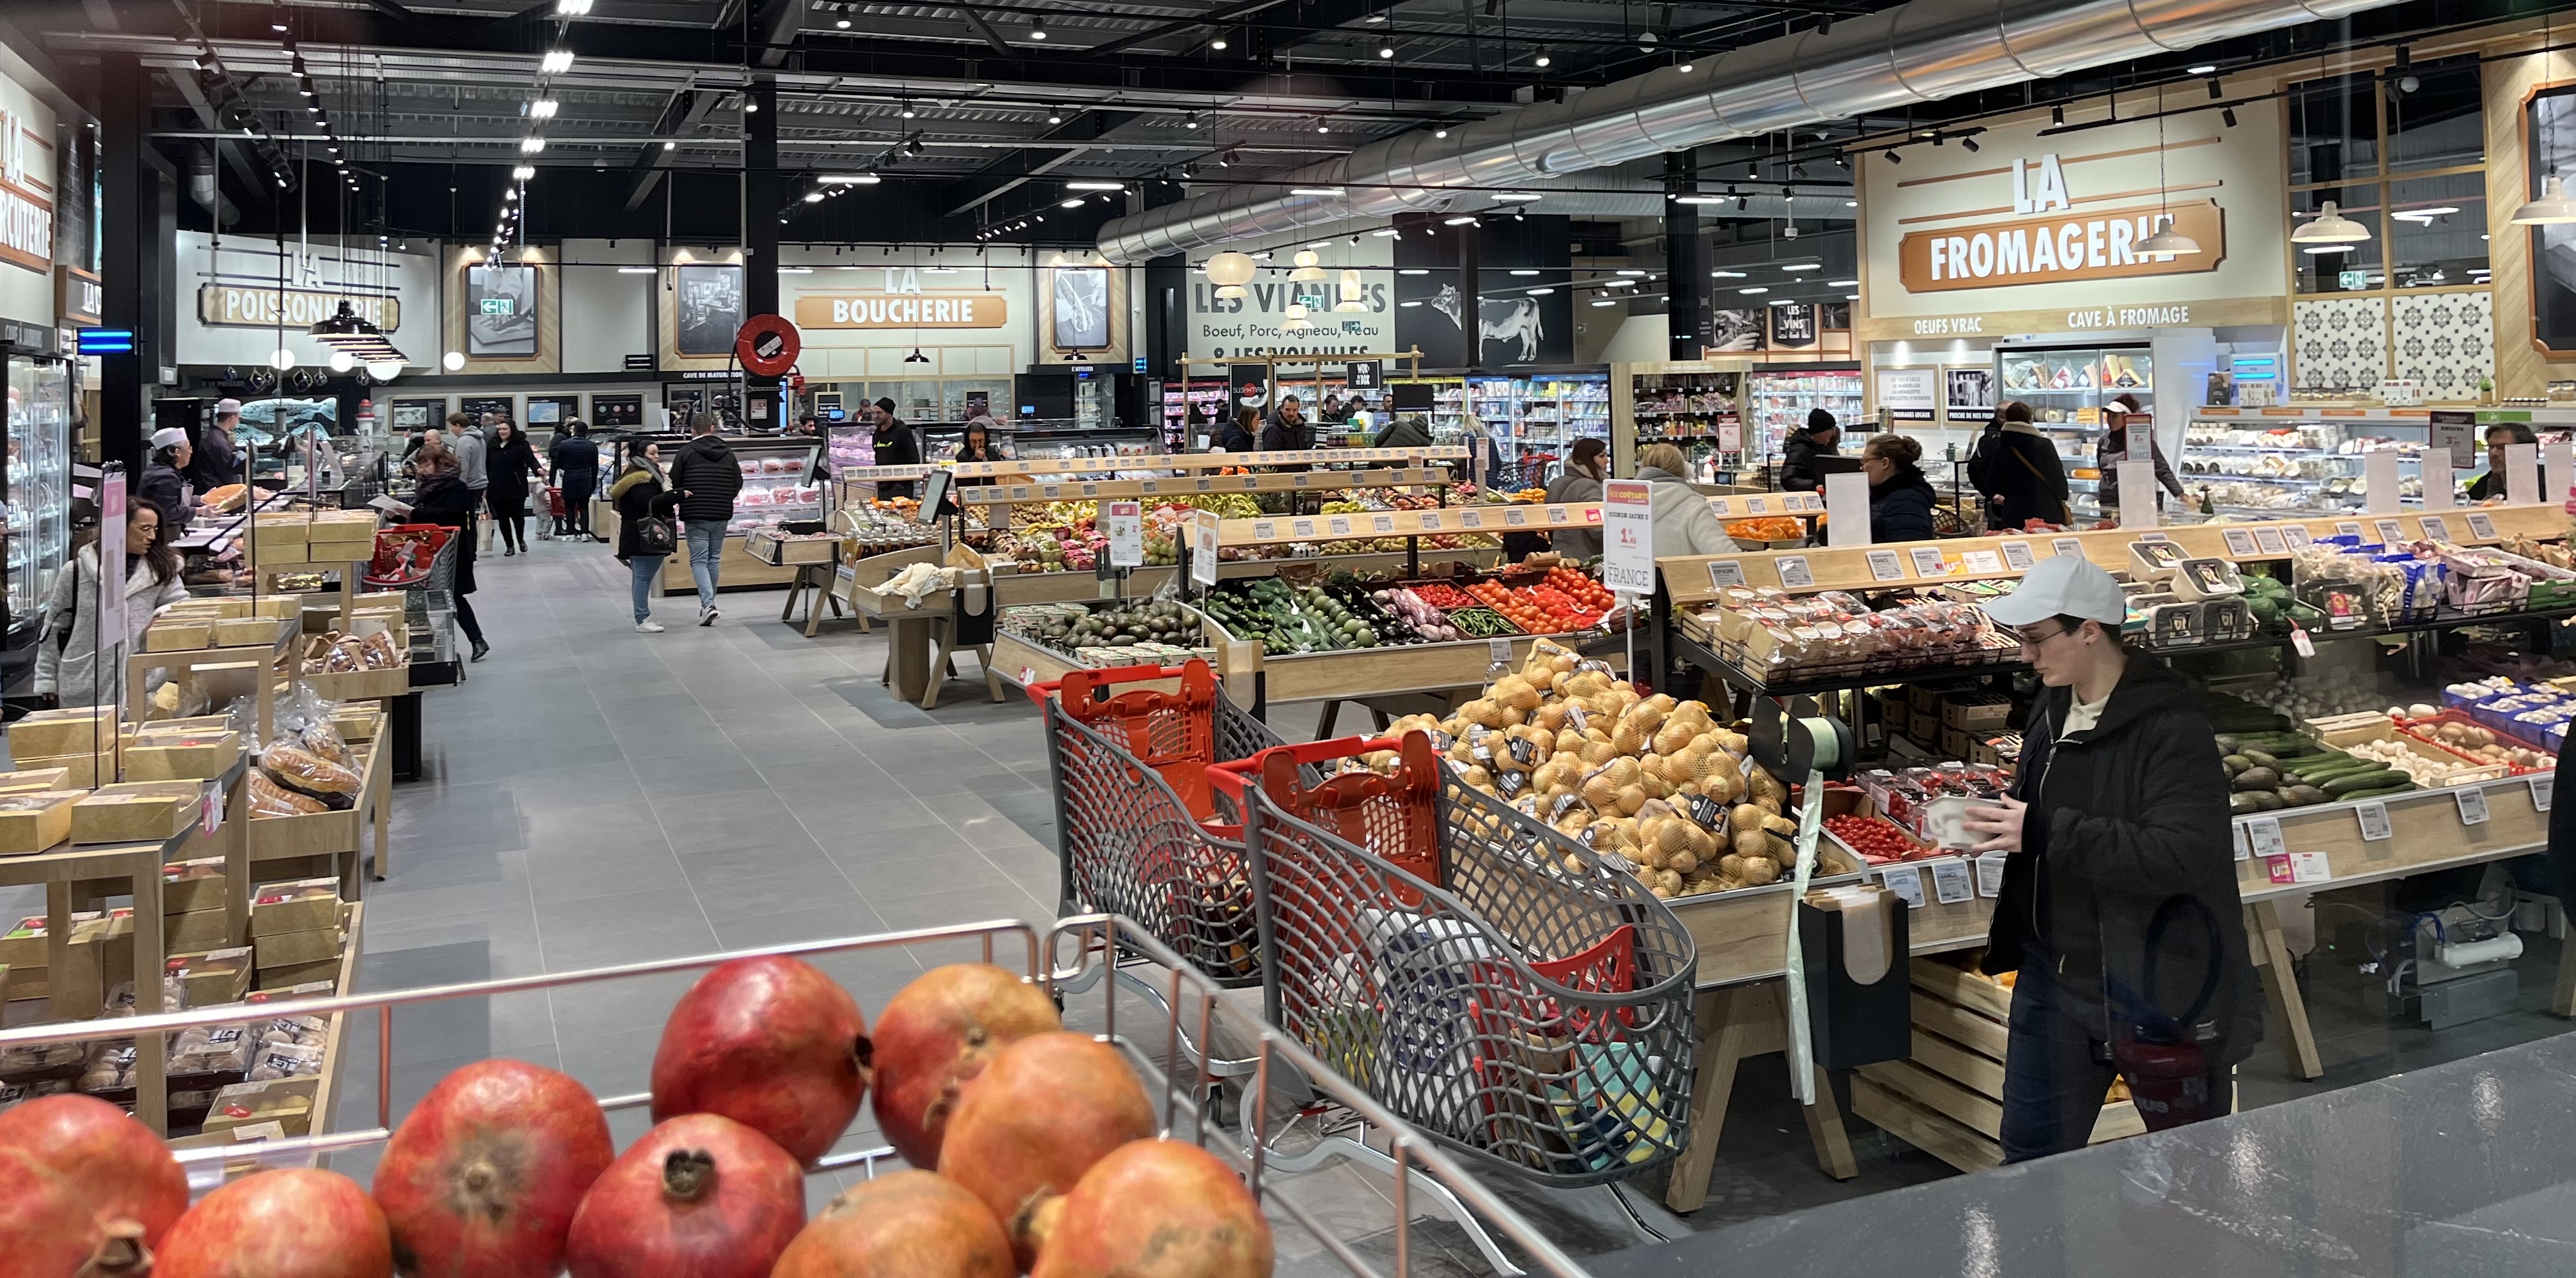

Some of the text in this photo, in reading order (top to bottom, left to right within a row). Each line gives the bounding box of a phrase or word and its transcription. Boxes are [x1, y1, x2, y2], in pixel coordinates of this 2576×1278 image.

[6, 109, 25, 183] LA
[2012, 153, 2070, 215] LA
[291, 251, 324, 288] LA
[885, 267, 921, 294] LA
[226, 290, 382, 326] POISSONNRIE
[1195, 283, 1386, 313] LES VIANES
[834, 299, 973, 323] BOUCHERIE
[1787, 306, 1800, 315] LES
[2068, 305, 2189, 328] CAVE À FROMAGE
[1203, 324, 1245, 339] Boeuf,
[1250, 324, 1281, 339] Porc,
[1784, 319, 1804, 329] VINS
[1914, 316, 1982, 335] OEUFS VRAC
[1608, 566, 1649, 587] FRANCE
